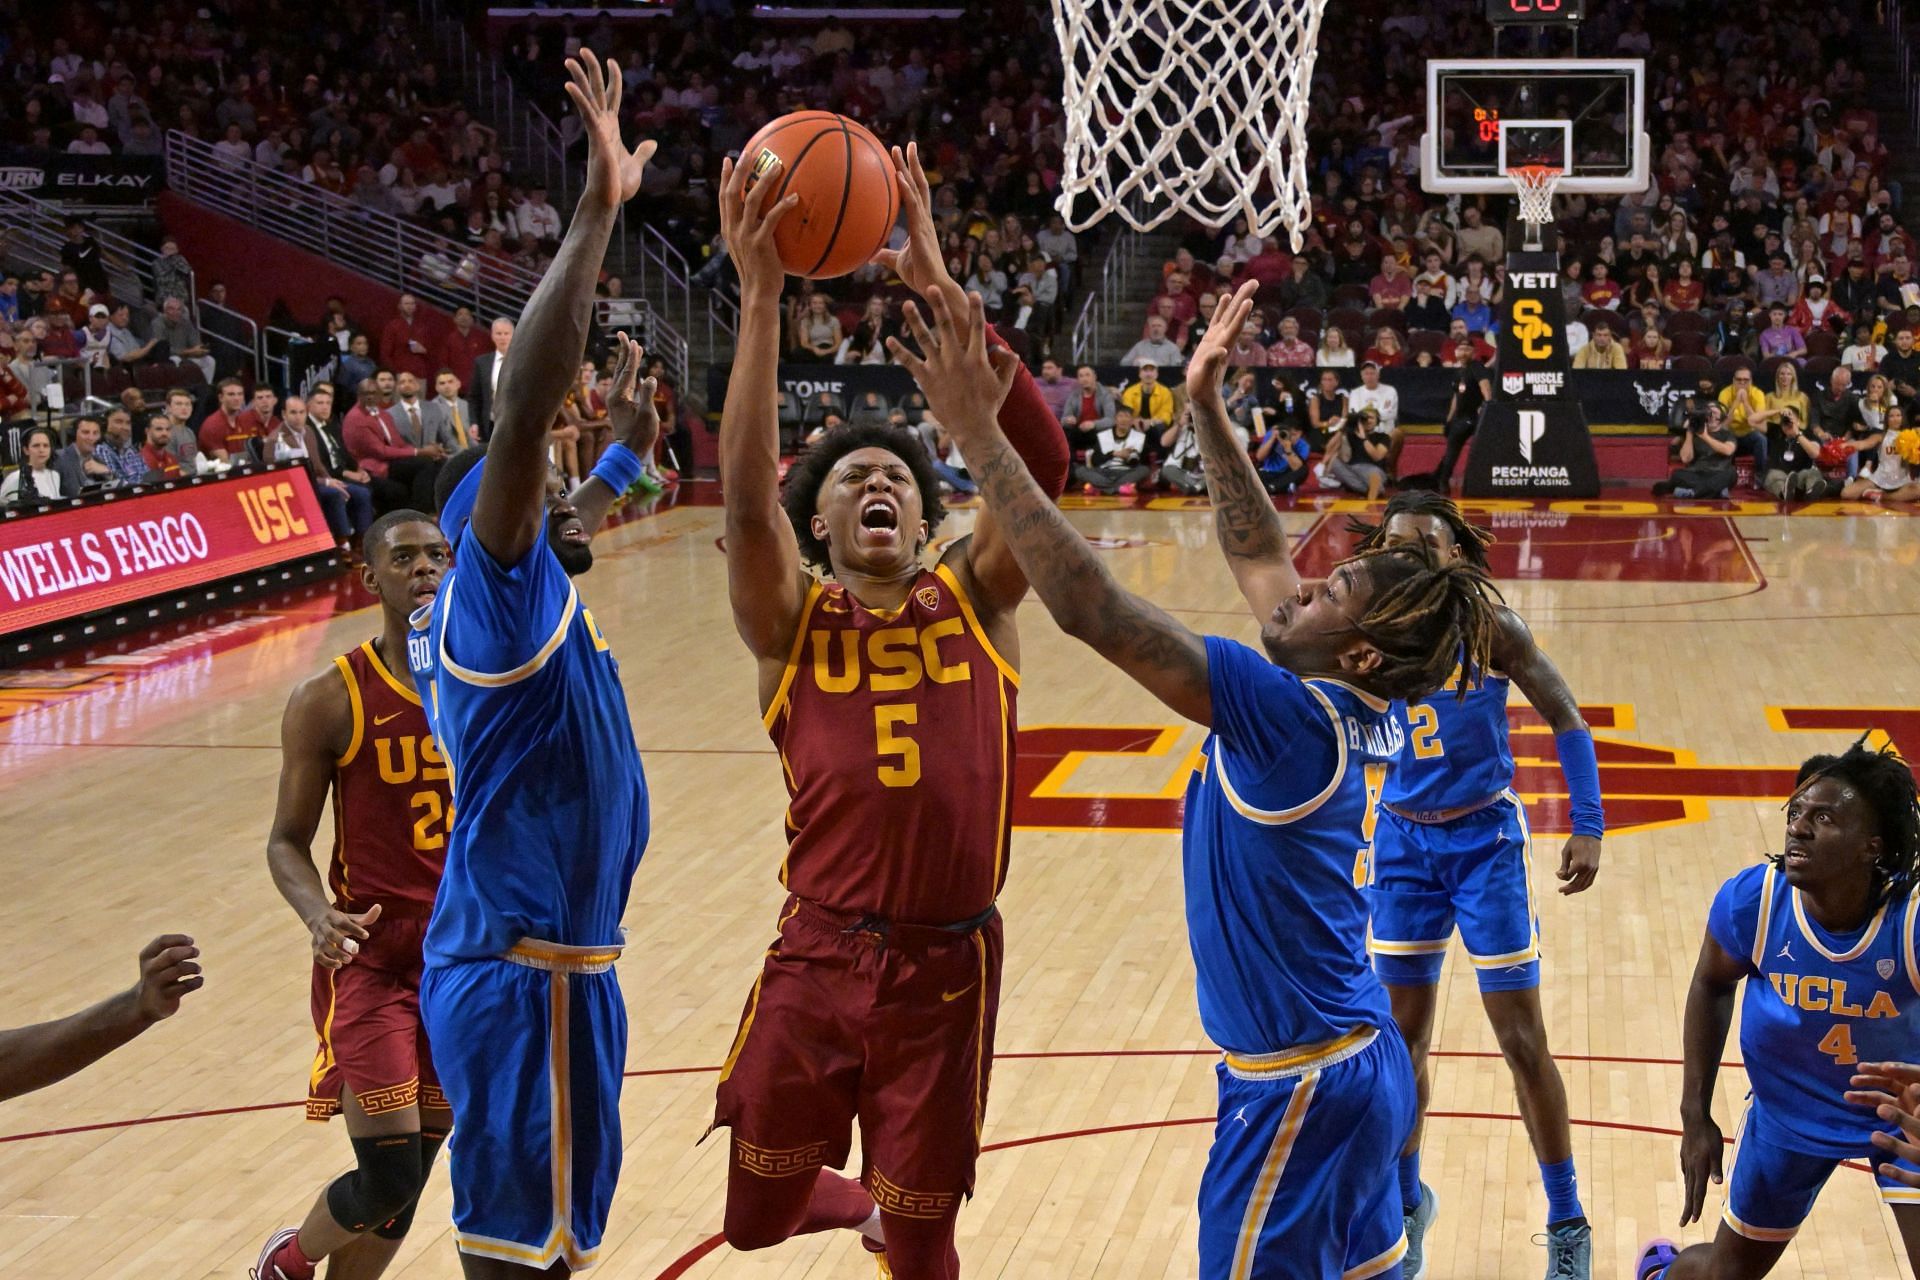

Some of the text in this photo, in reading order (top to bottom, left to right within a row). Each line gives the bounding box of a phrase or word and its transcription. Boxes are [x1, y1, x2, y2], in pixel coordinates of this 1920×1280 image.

[57, 173, 152, 188] ELKAY
[1509, 272, 1558, 289] YETI
[1525, 372, 1563, 384] MUSCLE
[1532, 384, 1557, 395] MILK
[1492, 466, 1568, 478] PECHANGA
[237, 482, 309, 544] USC
[0, 511, 208, 602] WELLS FARGO
[408, 636, 434, 673] BO
[811, 617, 971, 693] USC
[875, 703, 921, 787] 5
[1406, 703, 1445, 760] 2
[374, 735, 449, 785] US
[1769, 972, 1901, 1019] UCLA
[1817, 1023, 1858, 1065] 4
